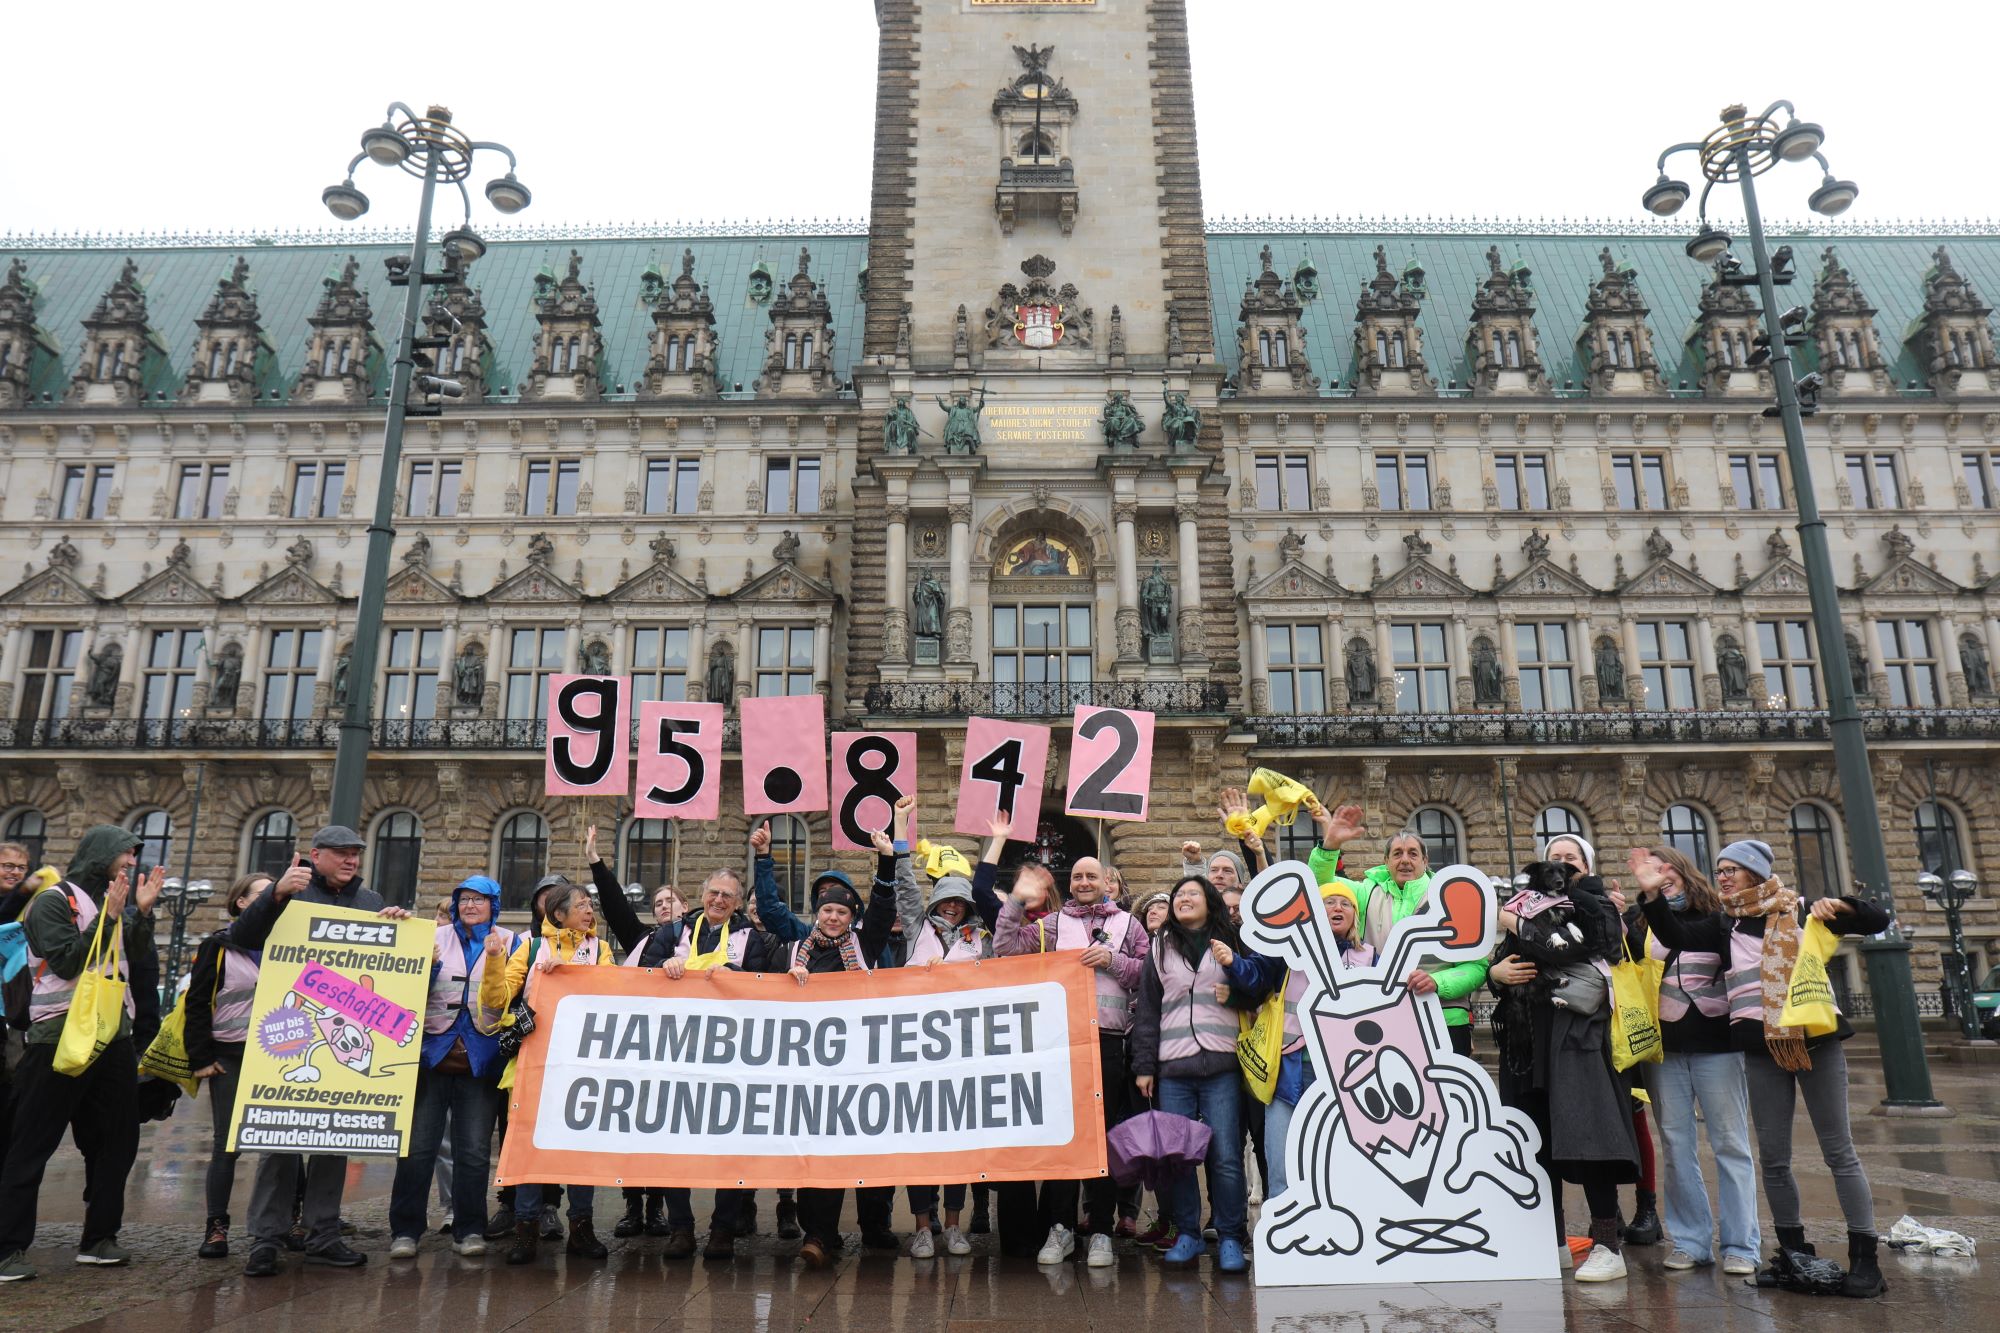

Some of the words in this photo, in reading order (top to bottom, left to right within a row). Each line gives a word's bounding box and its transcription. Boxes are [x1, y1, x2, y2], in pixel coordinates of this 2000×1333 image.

[990, 418, 1027, 428] MAIORES
[1056, 418, 1092, 428] STUDEAT
[997, 430, 1033, 440] SERVARE
[311, 920, 395, 944] Jetzt
[268, 944, 426, 975] unterschreiben!
[264, 1020, 285, 1033] nur
[287, 1015, 305, 1028] bis
[577, 1012, 847, 1067] HAMBURG
[862, 1001, 1039, 1064] TESTET
[267, 1029, 308, 1045] 30.09.
[250, 1084, 403, 1107] Volksbegehren:
[564, 1071, 1044, 1137] GRUNDEINKOMMEN
[246, 1108, 329, 1129] Hamburg
[333, 1112, 386, 1129] testet
[240, 1127, 399, 1149] Grundeinkommen
